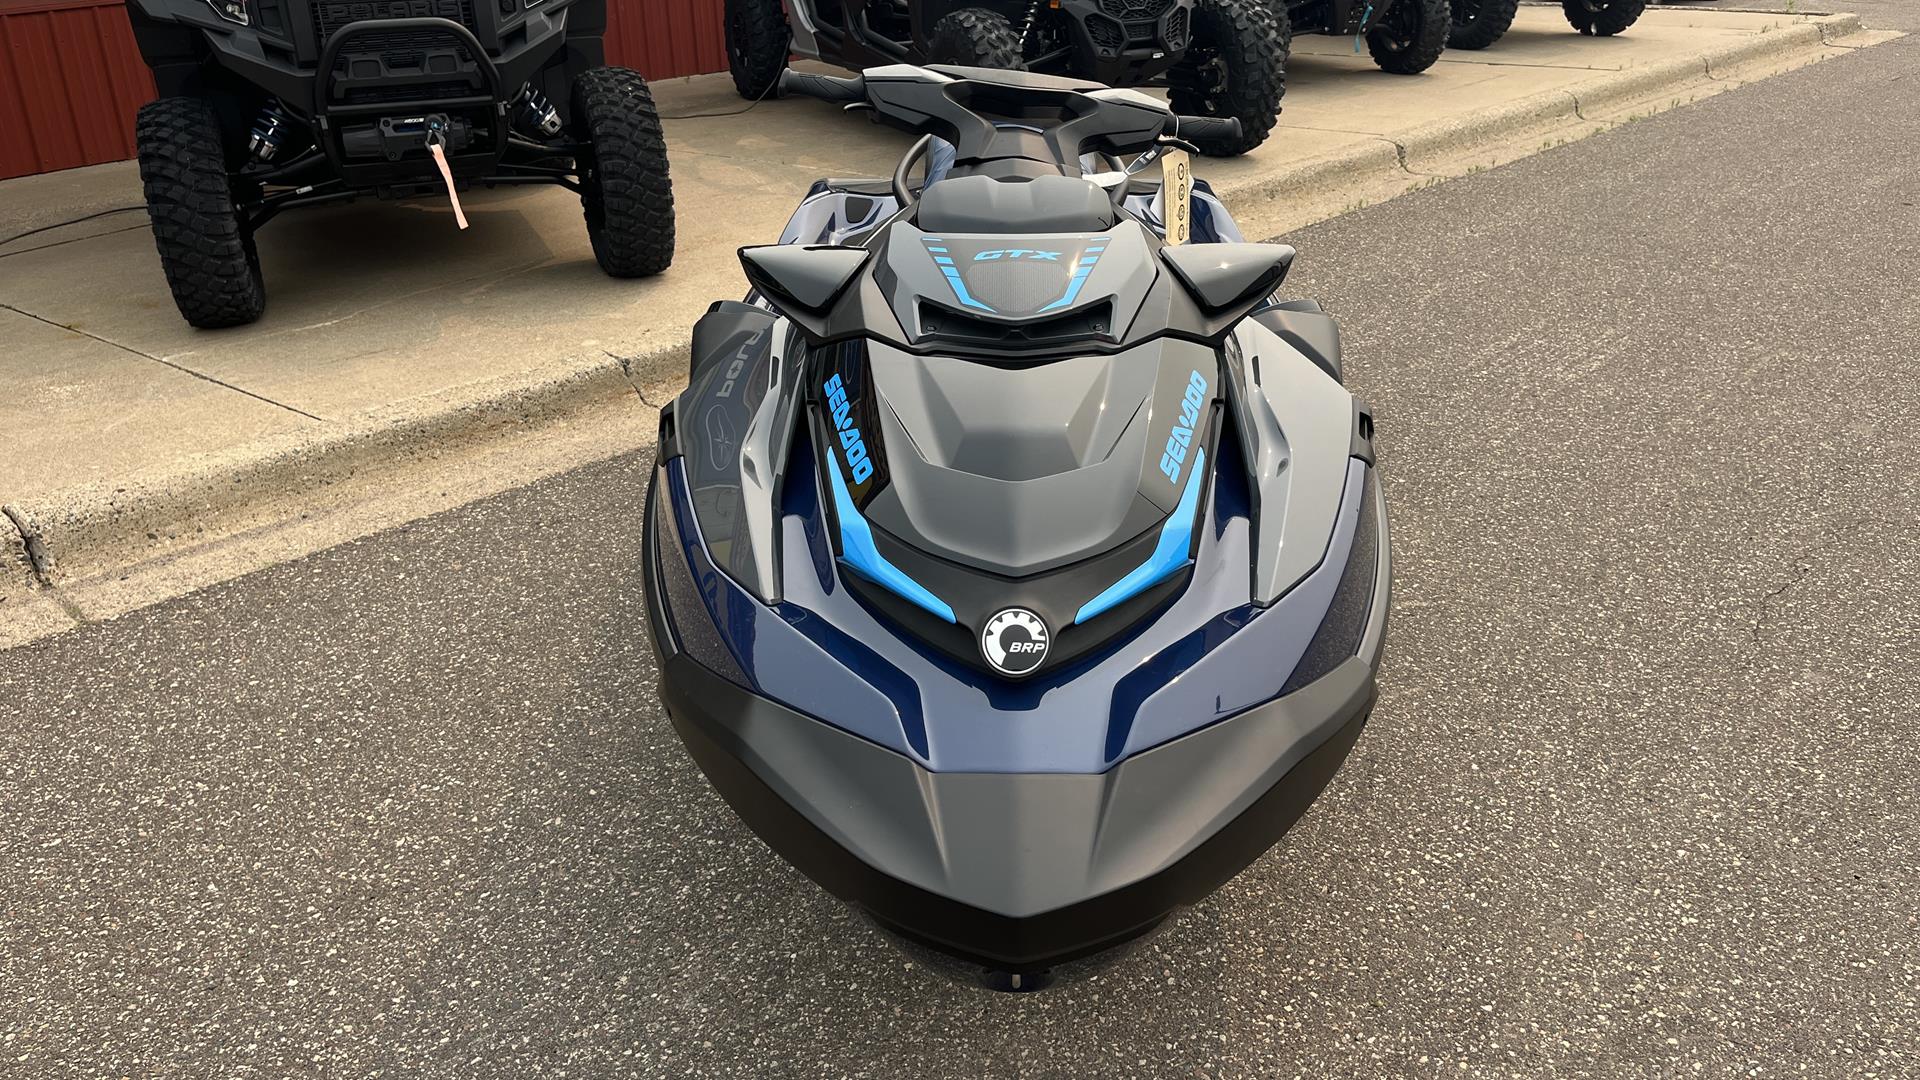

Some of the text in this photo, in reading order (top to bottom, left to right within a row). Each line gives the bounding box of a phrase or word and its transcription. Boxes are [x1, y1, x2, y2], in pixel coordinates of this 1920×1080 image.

[327, 1, 459, 22] POLARIS
[973, 249, 1064, 262] GTX
[1009, 641, 1046, 654] BRP
